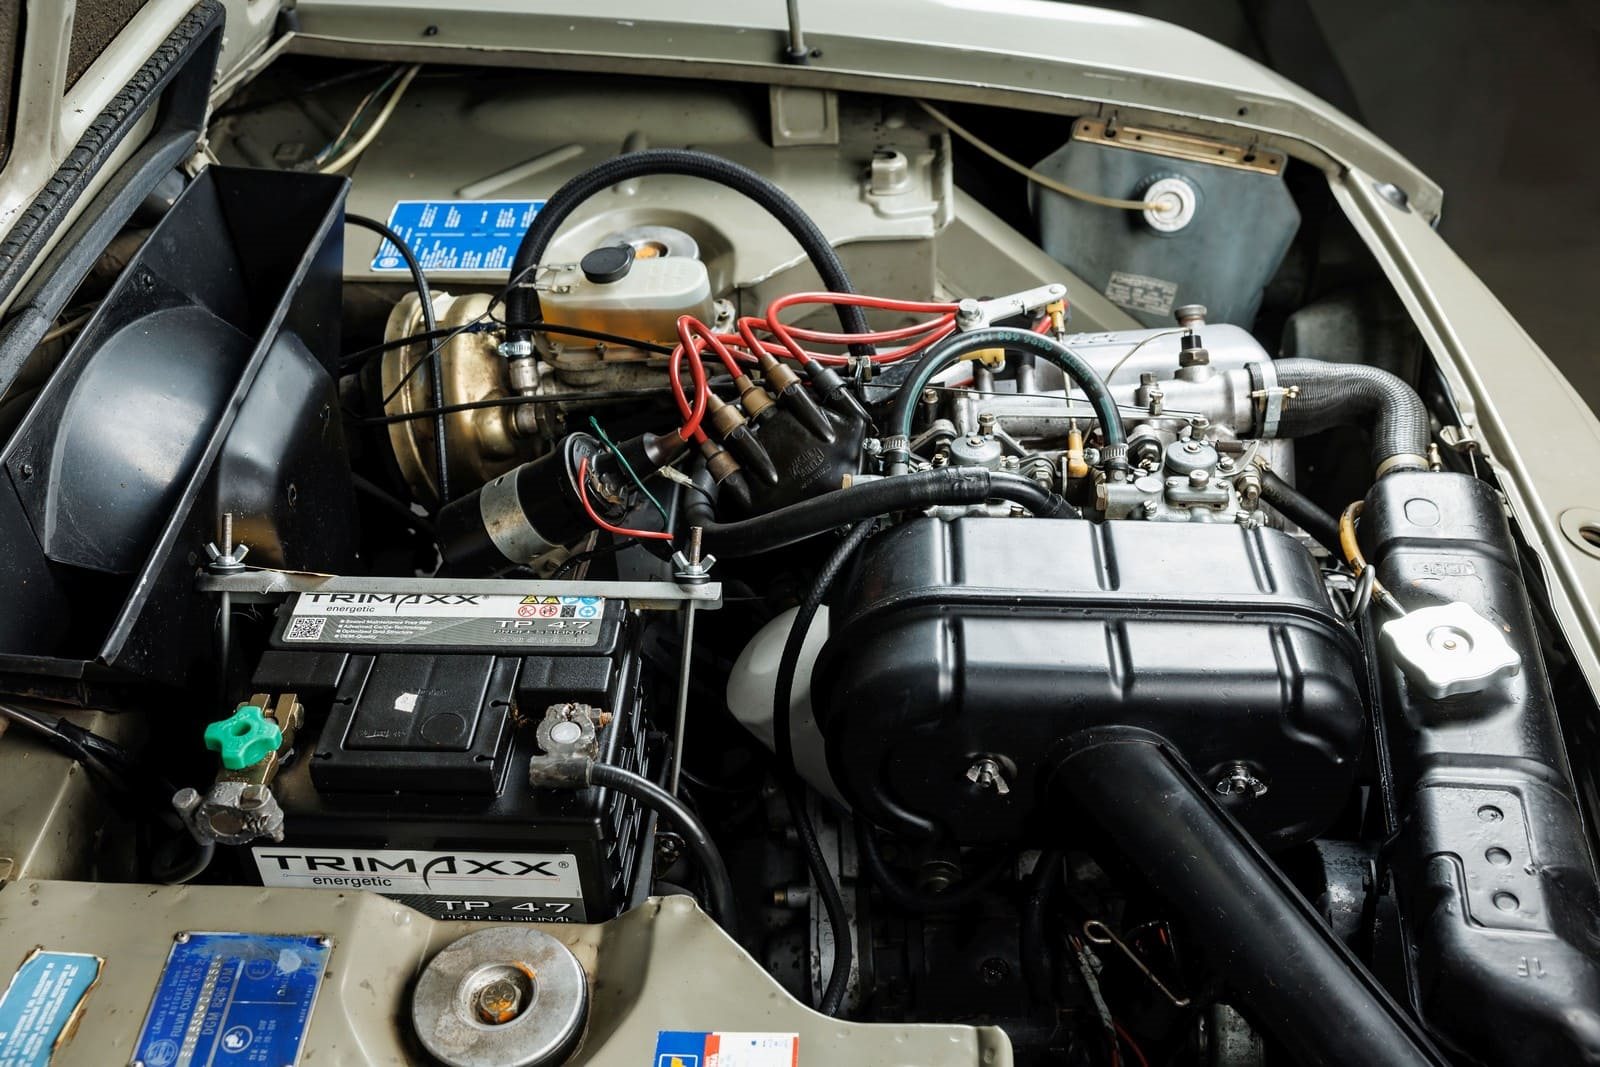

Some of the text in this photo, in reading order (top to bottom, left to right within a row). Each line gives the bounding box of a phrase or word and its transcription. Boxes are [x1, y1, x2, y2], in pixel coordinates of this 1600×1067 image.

[495, 620, 593, 629] TP 47
[312, 876, 393, 889] energetic
[436, 900, 571, 913] TP 47
[170, 1012, 186, 1036] FULVIA
[202, 1012, 218, 1034] DGM
